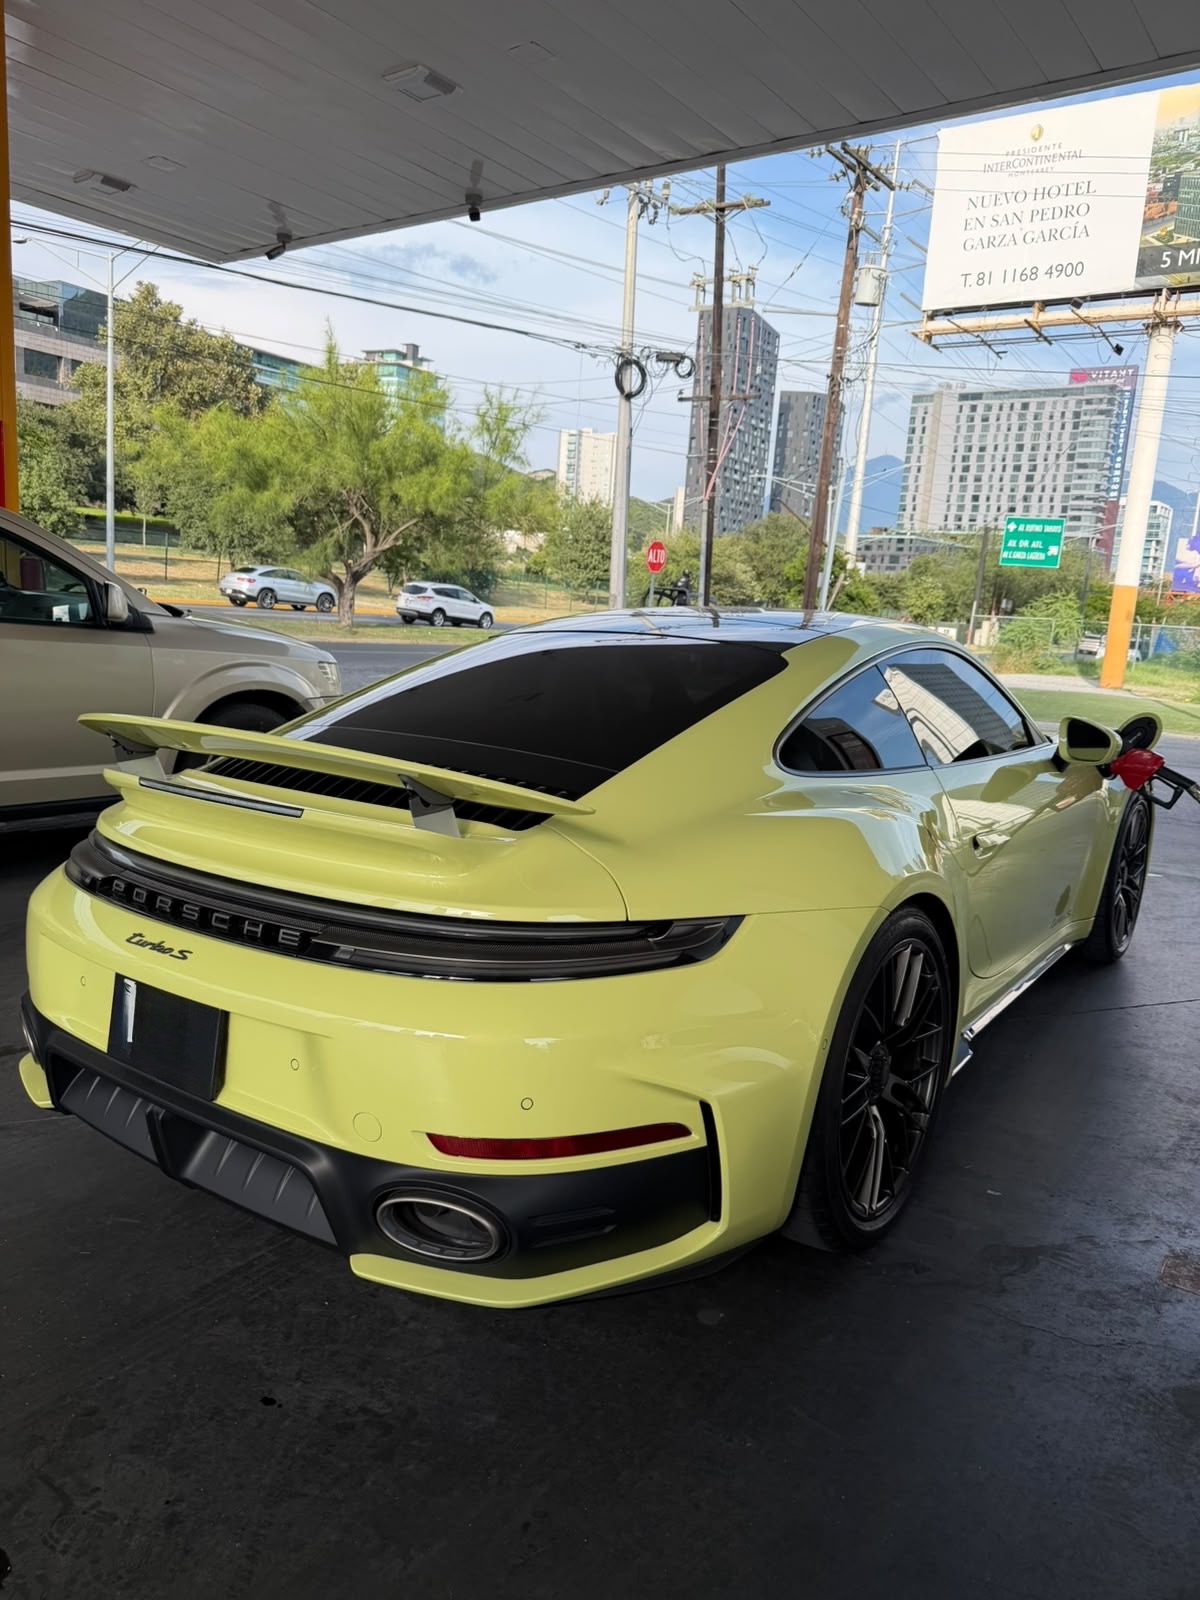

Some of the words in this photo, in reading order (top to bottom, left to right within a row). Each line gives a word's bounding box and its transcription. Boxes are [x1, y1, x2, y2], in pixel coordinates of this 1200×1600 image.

[983, 149, 1083, 173] INTERCONTINENTAL
[1005, 142, 1062, 157] PRESIDENTE
[967, 189, 1028, 210] NUEVO
[1033, 180, 1097, 201] HOTEL
[964, 215, 986, 231] EN
[990, 210, 1024, 228] SAN
[1030, 202, 1090, 223] PEDRO
[963, 232, 1018, 252] GARZA
[1022, 221, 1090, 245] GARCÍA
[1002, 266, 1039, 284] 1168
[1044, 261, 1085, 279] 4900
[1160, 251, 1172, 268] 5
[647, 549, 666, 564] ALTO
[111, 878, 301, 947] PORSCHE
[125, 931, 174, 956] turbo
[169, 948, 193, 961] S
